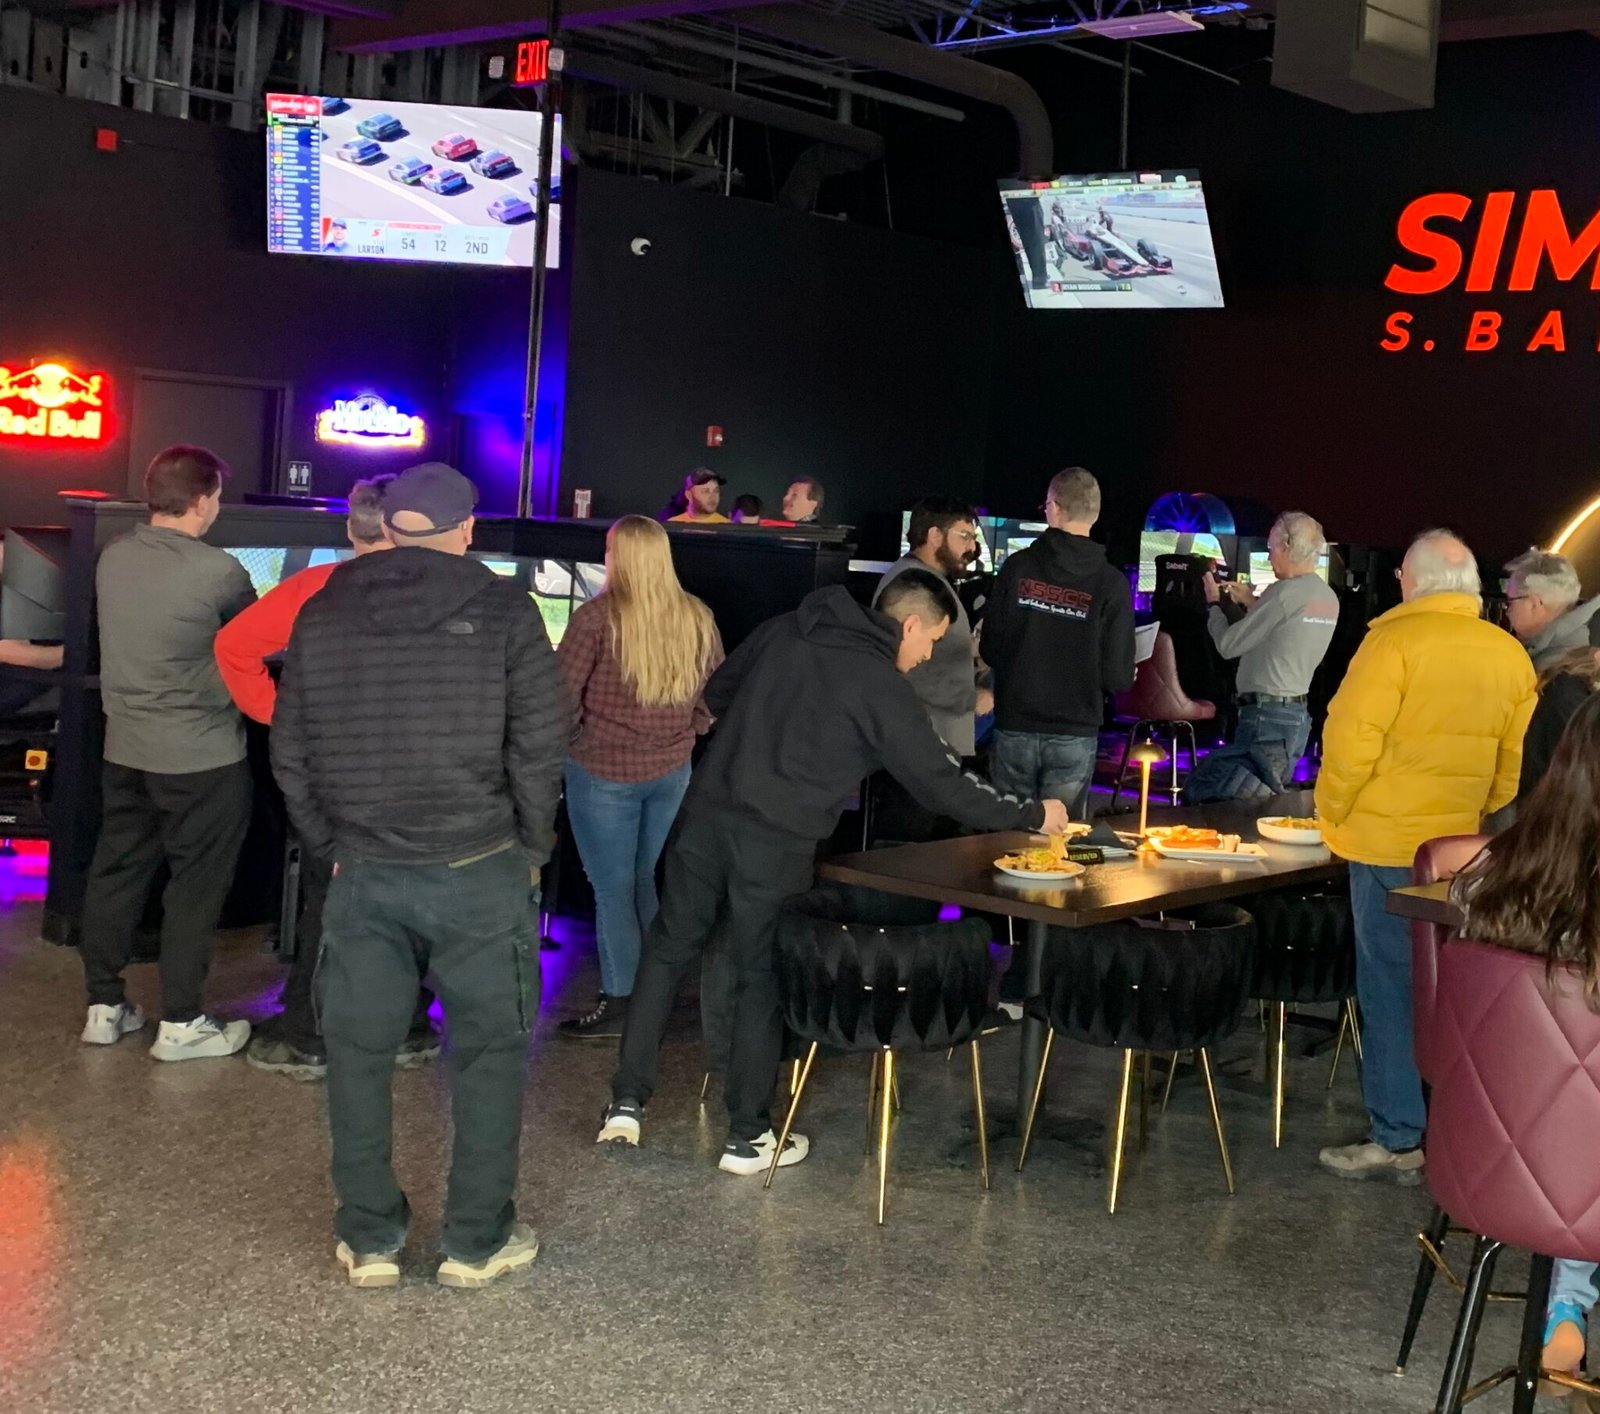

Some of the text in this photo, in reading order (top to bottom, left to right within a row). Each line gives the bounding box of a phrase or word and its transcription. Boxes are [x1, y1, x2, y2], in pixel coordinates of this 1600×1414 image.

[516, 40, 549, 82] EXIT
[357, 244, 385, 254] LARSON
[401, 238, 415, 250] 54
[435, 240, 447, 252] 12
[465, 242, 488, 254] 2ND
[1384, 189, 1600, 295] SIM
[1465, 310, 1600, 351] BA
[0, 405, 101, 440] Red Bull
